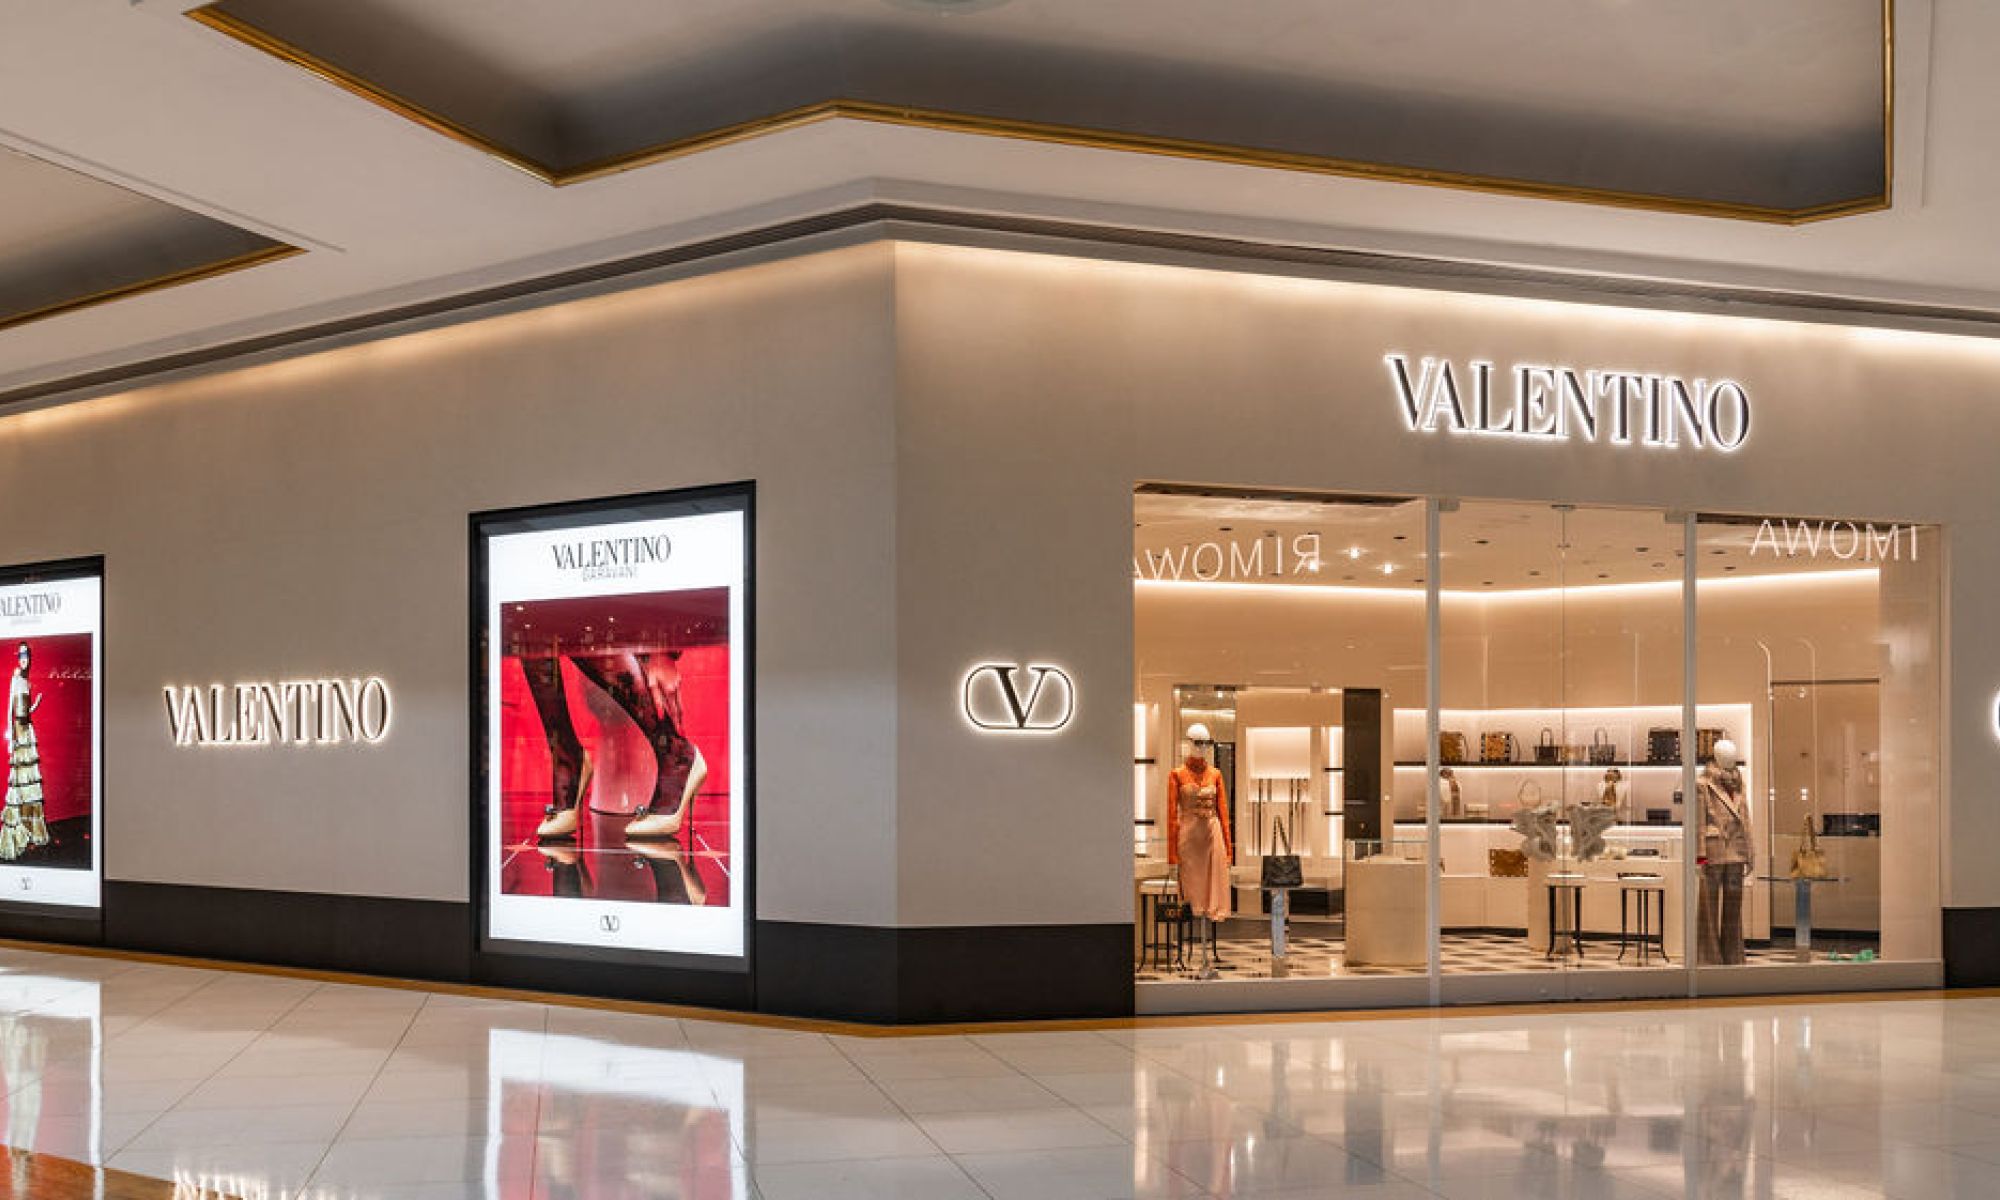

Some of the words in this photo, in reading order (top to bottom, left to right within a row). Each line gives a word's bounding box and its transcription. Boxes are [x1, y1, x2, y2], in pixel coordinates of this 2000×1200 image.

[1384, 354, 1750, 449] VALENTINO
[551, 534, 671, 569] VALENTINO
[163, 676, 391, 746] VALENTINO
